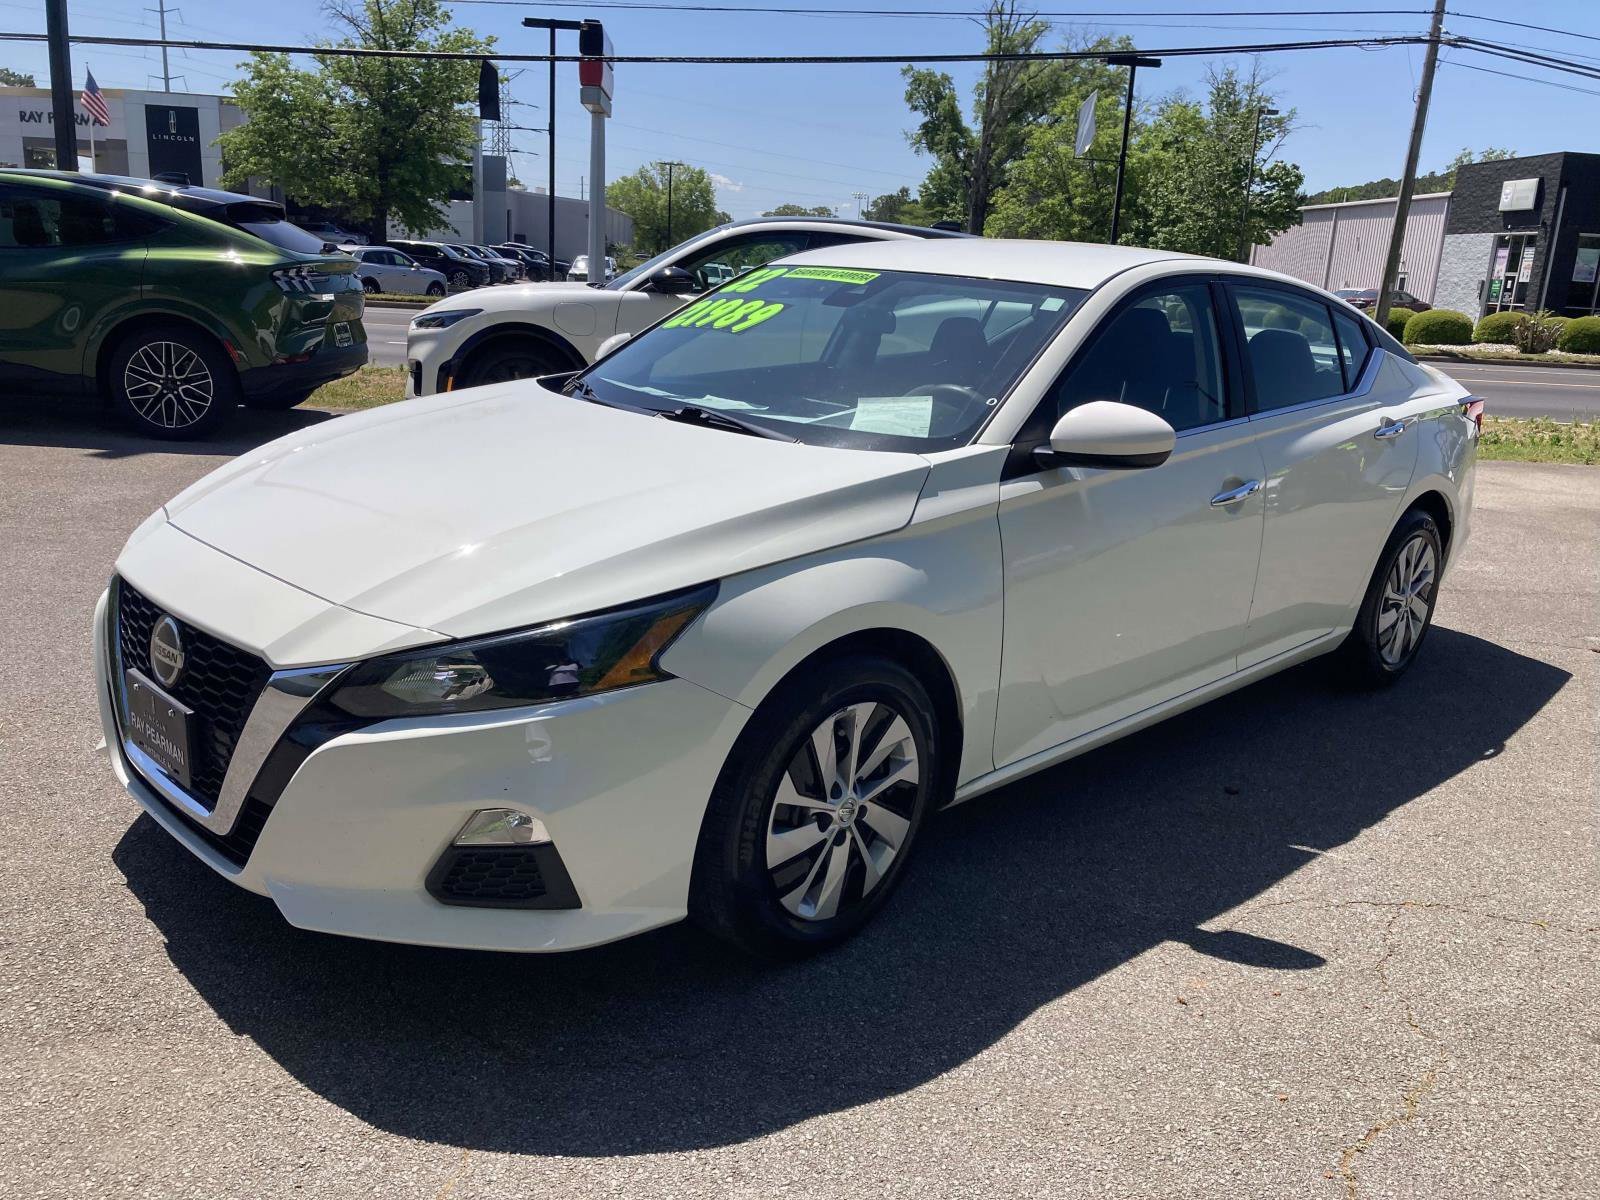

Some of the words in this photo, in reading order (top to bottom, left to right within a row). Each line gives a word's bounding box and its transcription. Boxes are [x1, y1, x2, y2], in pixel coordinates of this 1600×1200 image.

[19, 110, 43, 123] RAY
[152, 133, 195, 142] LINCOLN
[662, 298, 785, 333] 21989
[131, 711, 145, 734] RAY
[146, 723, 185, 766] PEARMAN
